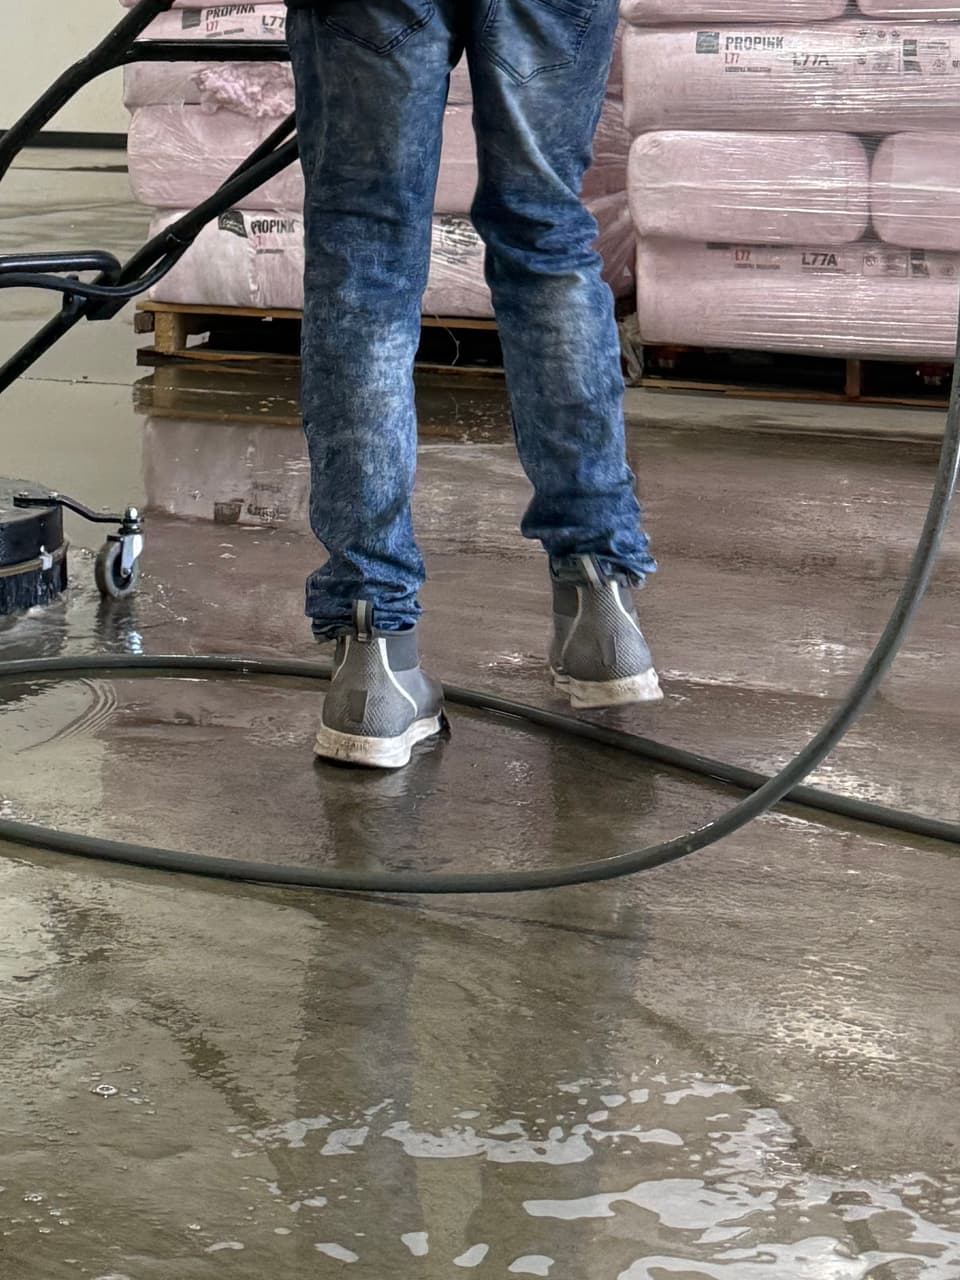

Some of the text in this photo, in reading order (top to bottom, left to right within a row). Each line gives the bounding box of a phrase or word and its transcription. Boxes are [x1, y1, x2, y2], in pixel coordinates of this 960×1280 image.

[206, 4, 256, 20] PROPINK
[206, 21, 219, 32] L77
[725, 36, 784, 51] PROPINK
[724, 52, 829, 66] L77 L77A
[734, 249, 838, 266] L77 L77A
